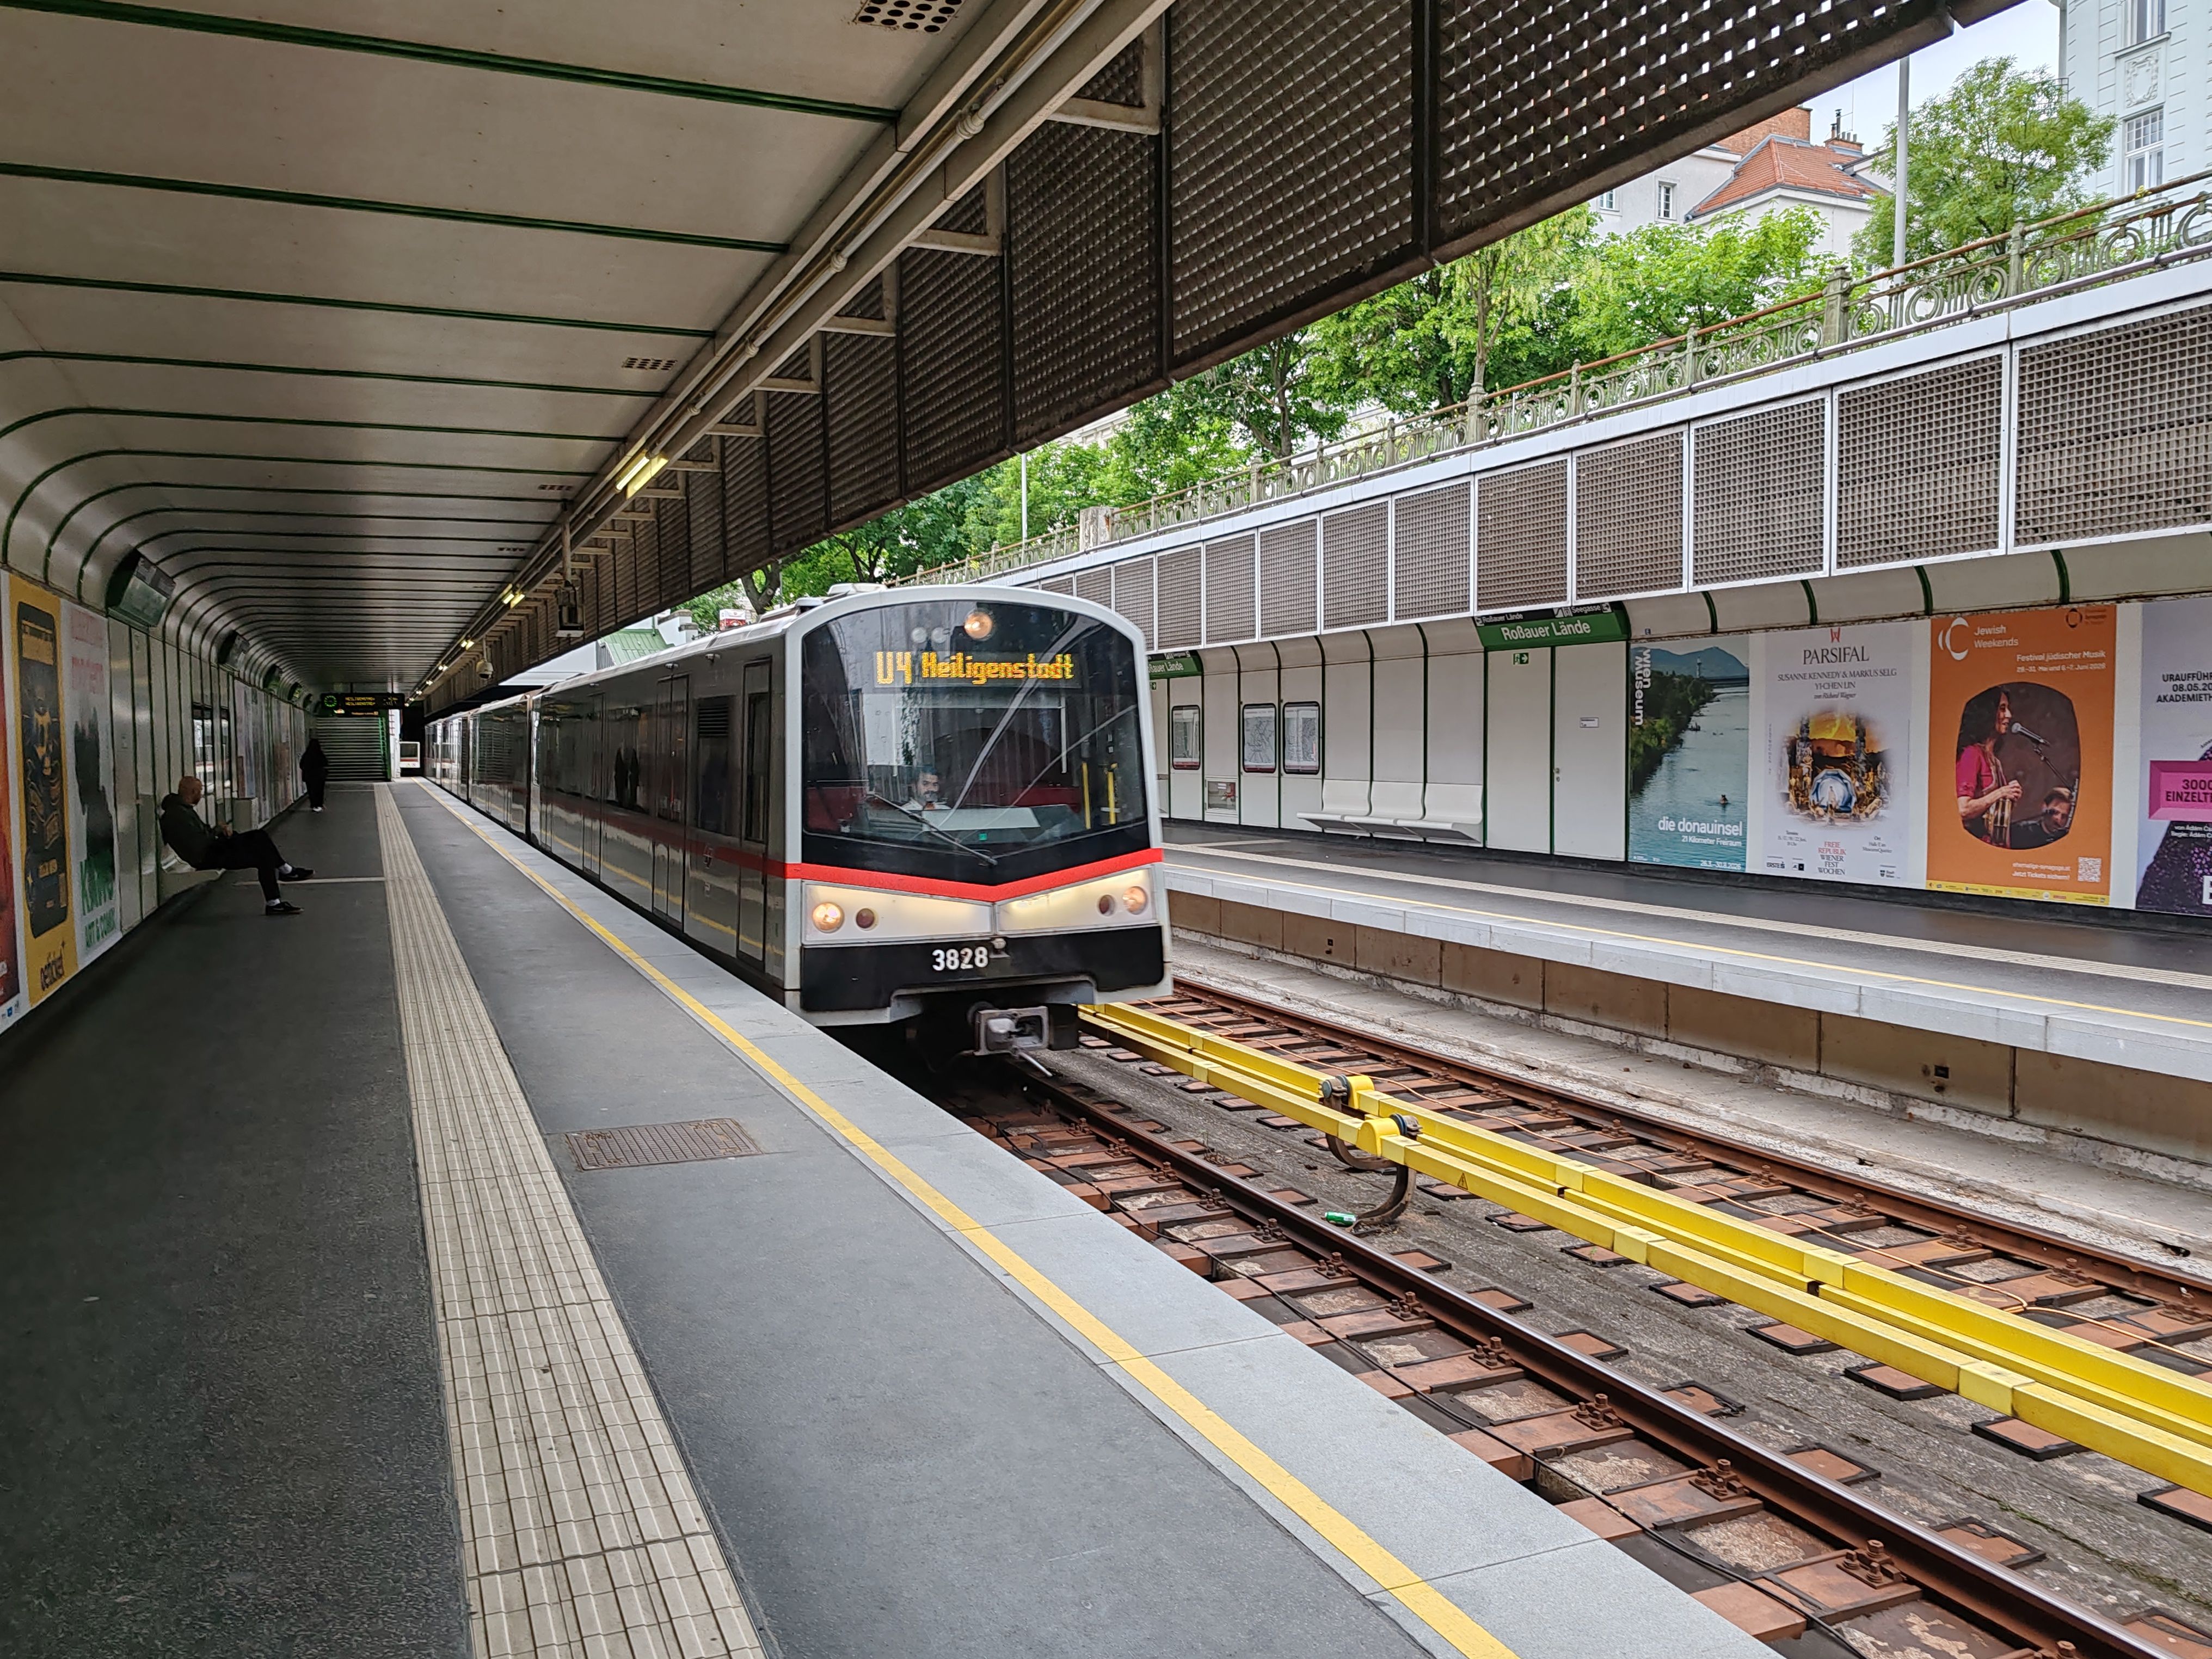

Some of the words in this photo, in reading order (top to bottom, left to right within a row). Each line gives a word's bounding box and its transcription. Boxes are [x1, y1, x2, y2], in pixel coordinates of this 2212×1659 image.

[1572, 604, 1601, 613] Seegasse
[1501, 625, 1550, 641] Roßauer
[1551, 620, 1591, 636] Lände
[1974, 625, 2006, 636] Jewish
[1974, 637, 2019, 648] Weekends
[1803, 646, 1870, 665] PARSIFAL
[2017, 653, 2045, 662] Festival
[2046, 652, 2081, 662] jüdischer
[2082, 650, 2106, 659] Musik
[876, 652, 912, 684] U4
[921, 652, 1074, 684] Heiligenstadt
[1147, 663, 1165, 673] oßauer
[1164, 661, 1184, 671] Lände
[1778, 671, 1808, 681] SUSANNE
[1809, 671, 1841, 679] KENNEDY
[1848, 669, 1878, 678] MARKUS
[1879, 668, 1897, 677] SELG
[1658, 816, 1676, 831] die
[1678, 818, 1742, 836] donauinsel
[1688, 836, 1715, 845] Kilometer
[1716, 838, 1742, 847] Freiraum
[1817, 867, 1845, 875] WOCHEN
[932, 946, 988, 971] 3828
